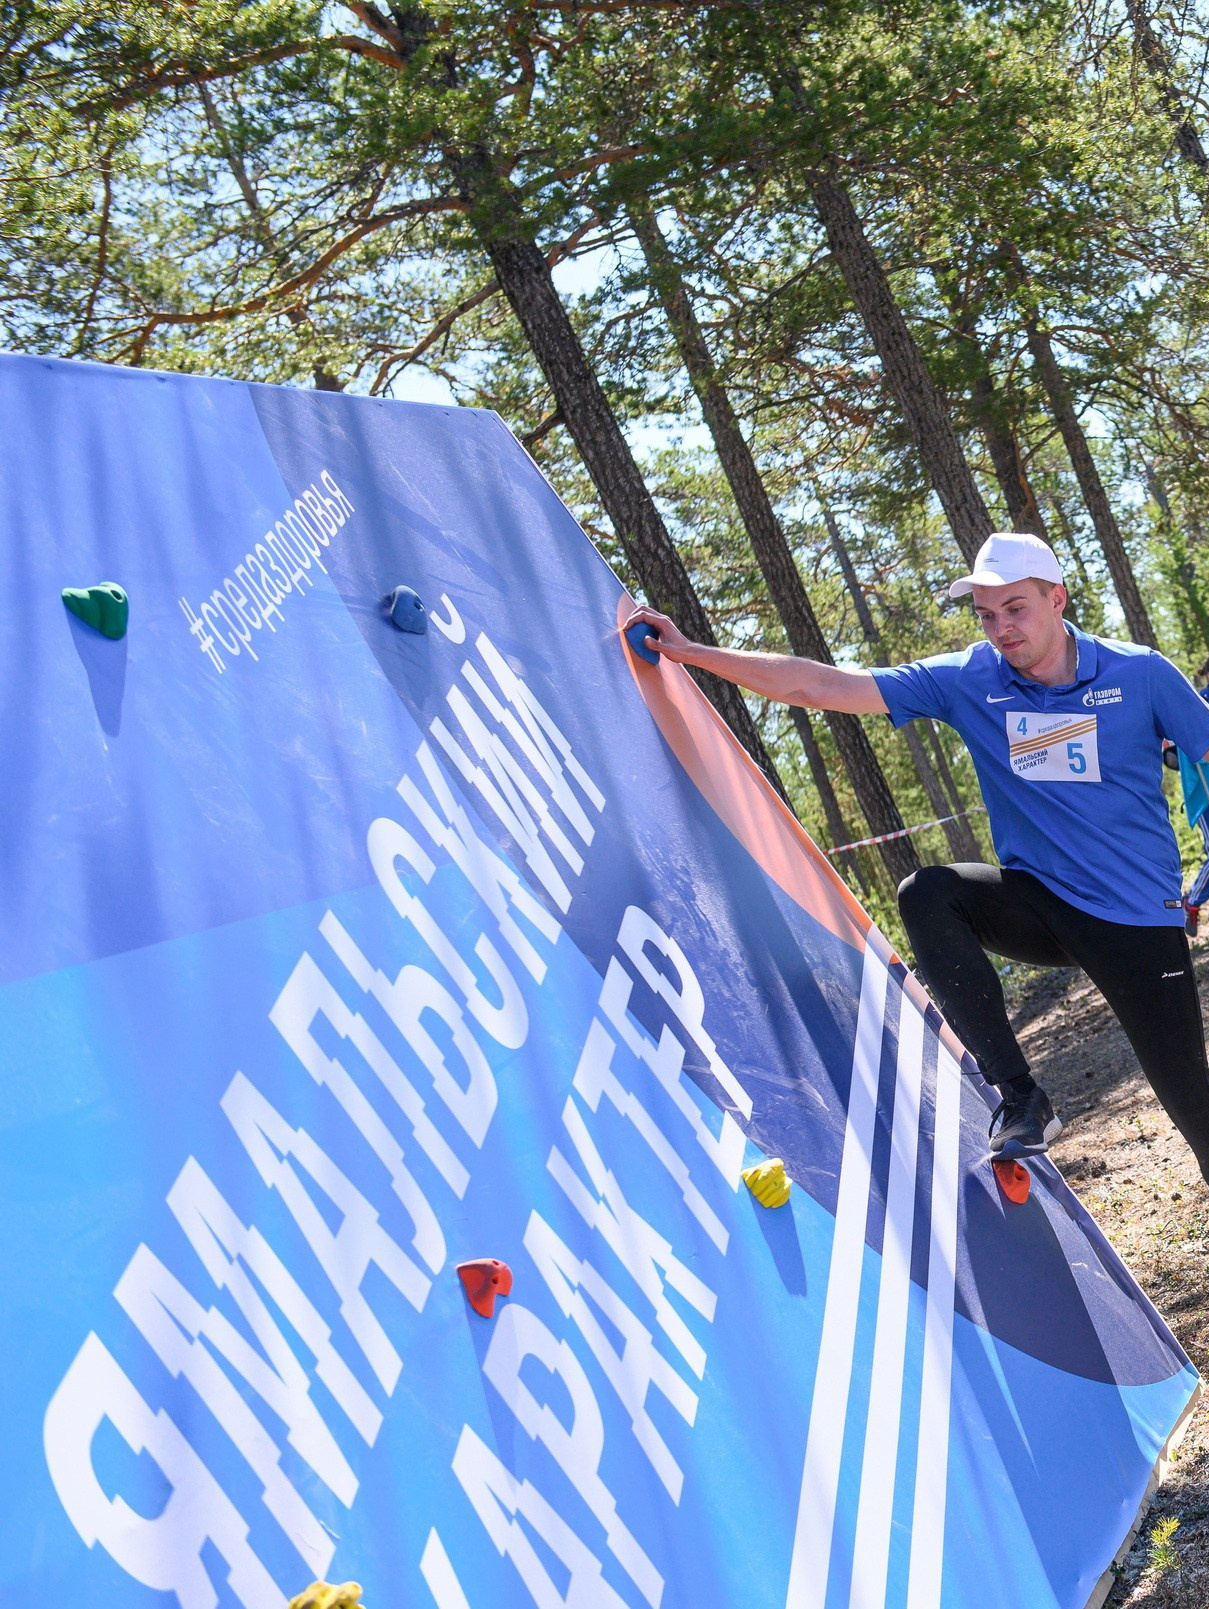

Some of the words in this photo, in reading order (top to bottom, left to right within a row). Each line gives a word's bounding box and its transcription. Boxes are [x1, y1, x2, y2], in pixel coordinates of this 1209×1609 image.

[177, 469, 356, 673] #средаздоровья
[1094, 688, 1122, 700] ГАЗПРОМ
[1016, 716, 1028, 736] 4
[1013, 749, 1049, 766] ЯМАЛЬСКИЙ
[1018, 757, 1048, 772] ХАРАКТЕР
[1066, 742, 1087, 775] 5
[43, 593, 606, 1609] ЯМАЛЬСКИЙ
[420, 905, 753, 1609] АРАКТЕР
